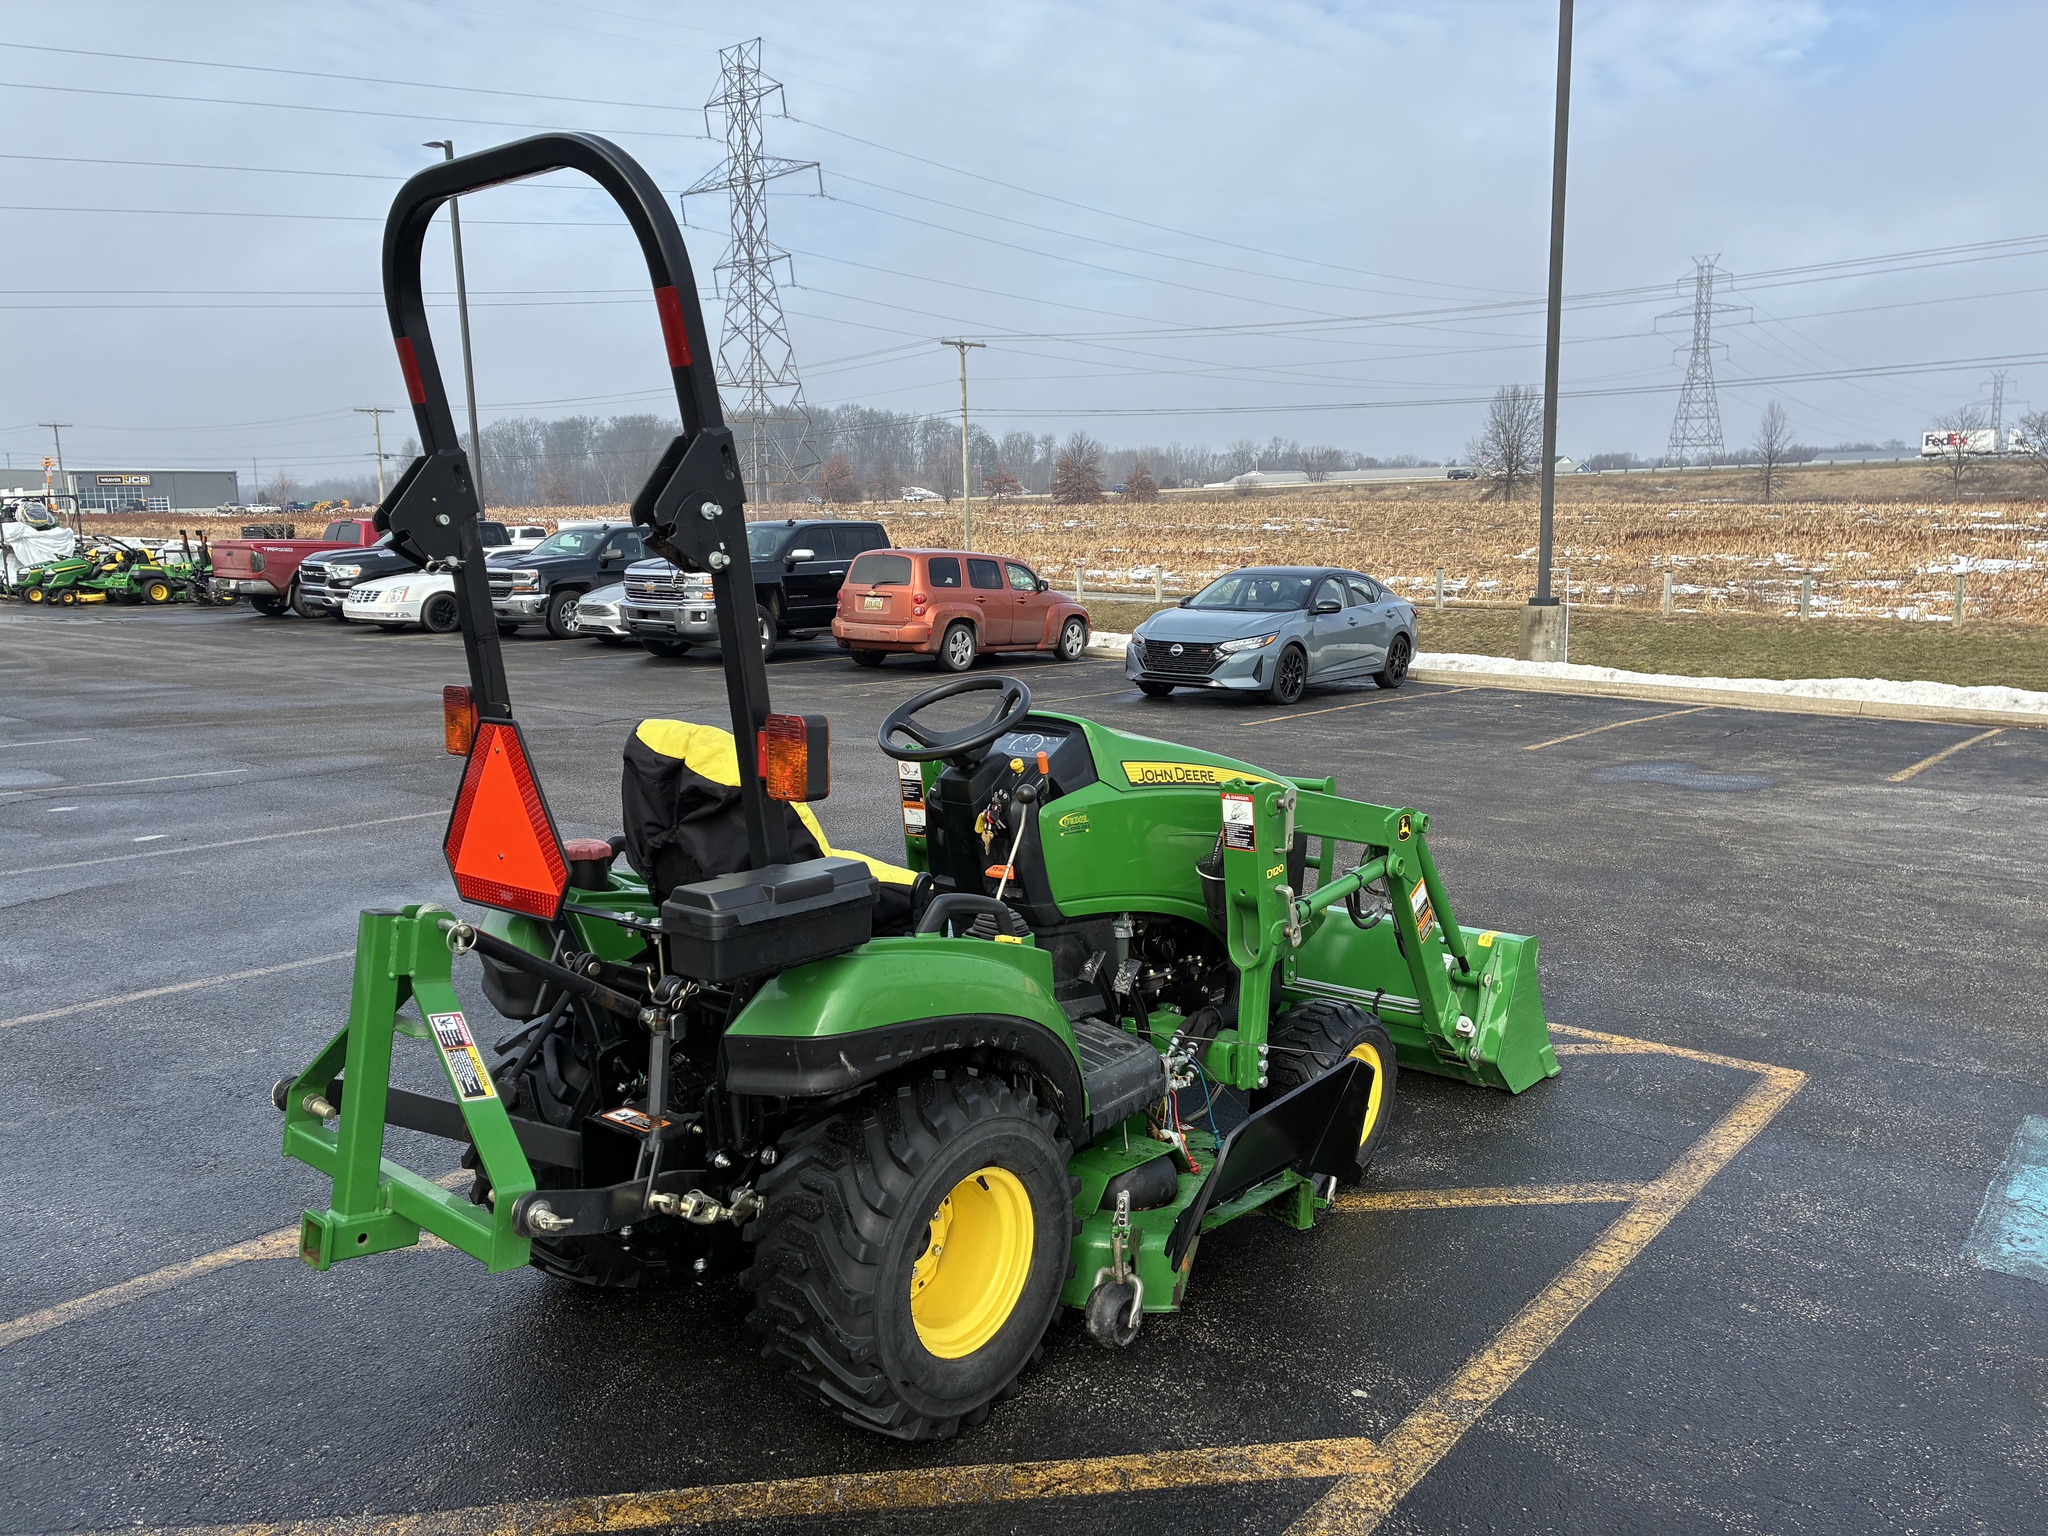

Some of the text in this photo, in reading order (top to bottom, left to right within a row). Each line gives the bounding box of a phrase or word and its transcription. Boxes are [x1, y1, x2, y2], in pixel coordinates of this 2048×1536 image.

[1925, 433, 1967, 447] FedEx
[1138, 767, 1216, 782] JOHN DEERE
[1266, 863, 1284, 880] D120
[457, 1019, 472, 1044] DANGER
[474, 1060, 489, 1087] CAUTION
